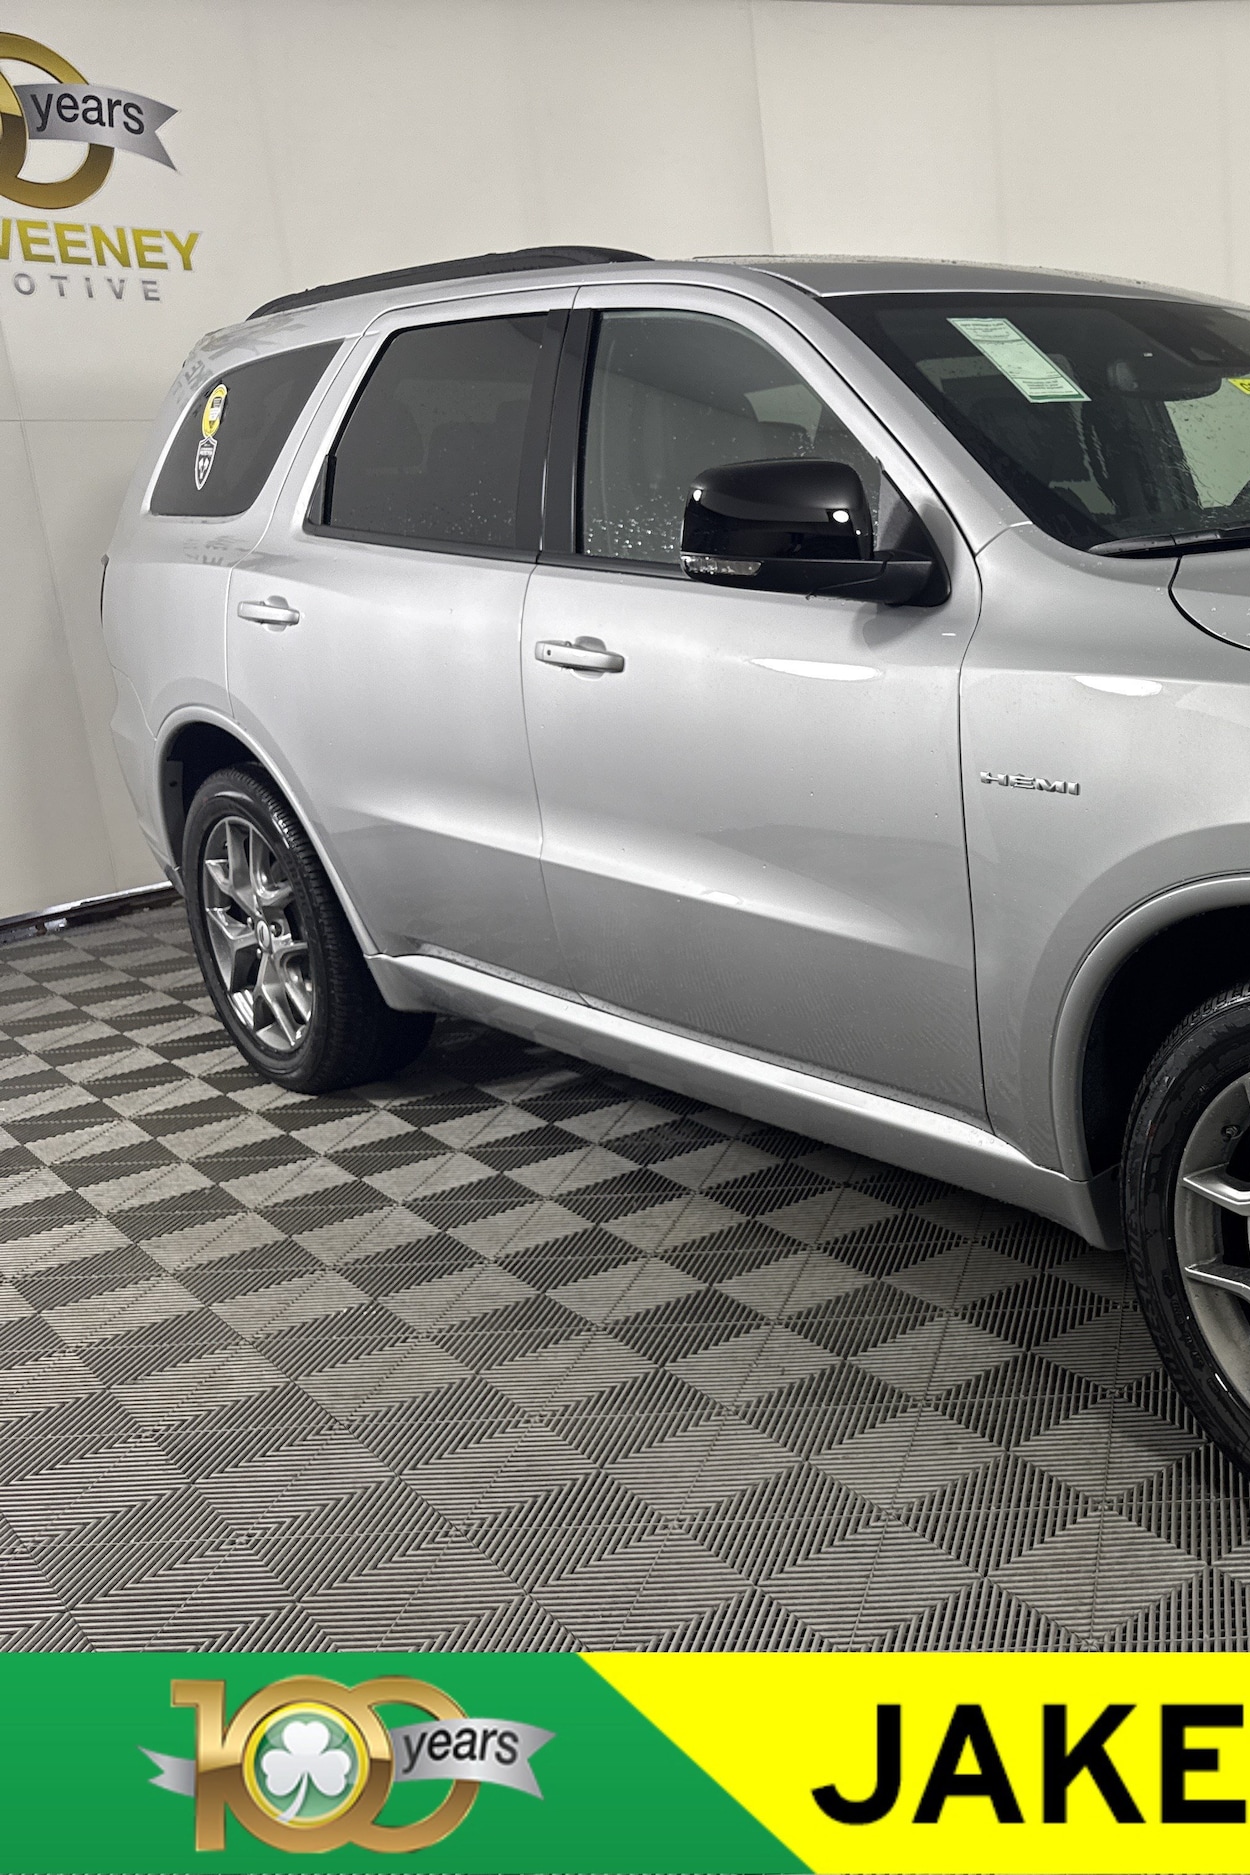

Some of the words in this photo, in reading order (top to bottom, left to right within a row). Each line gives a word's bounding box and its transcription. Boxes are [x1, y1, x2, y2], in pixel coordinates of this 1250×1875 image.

[30, 93, 145, 135] years
[0, 218, 200, 271] EENEY
[980, 771, 1080, 796] HEMI
